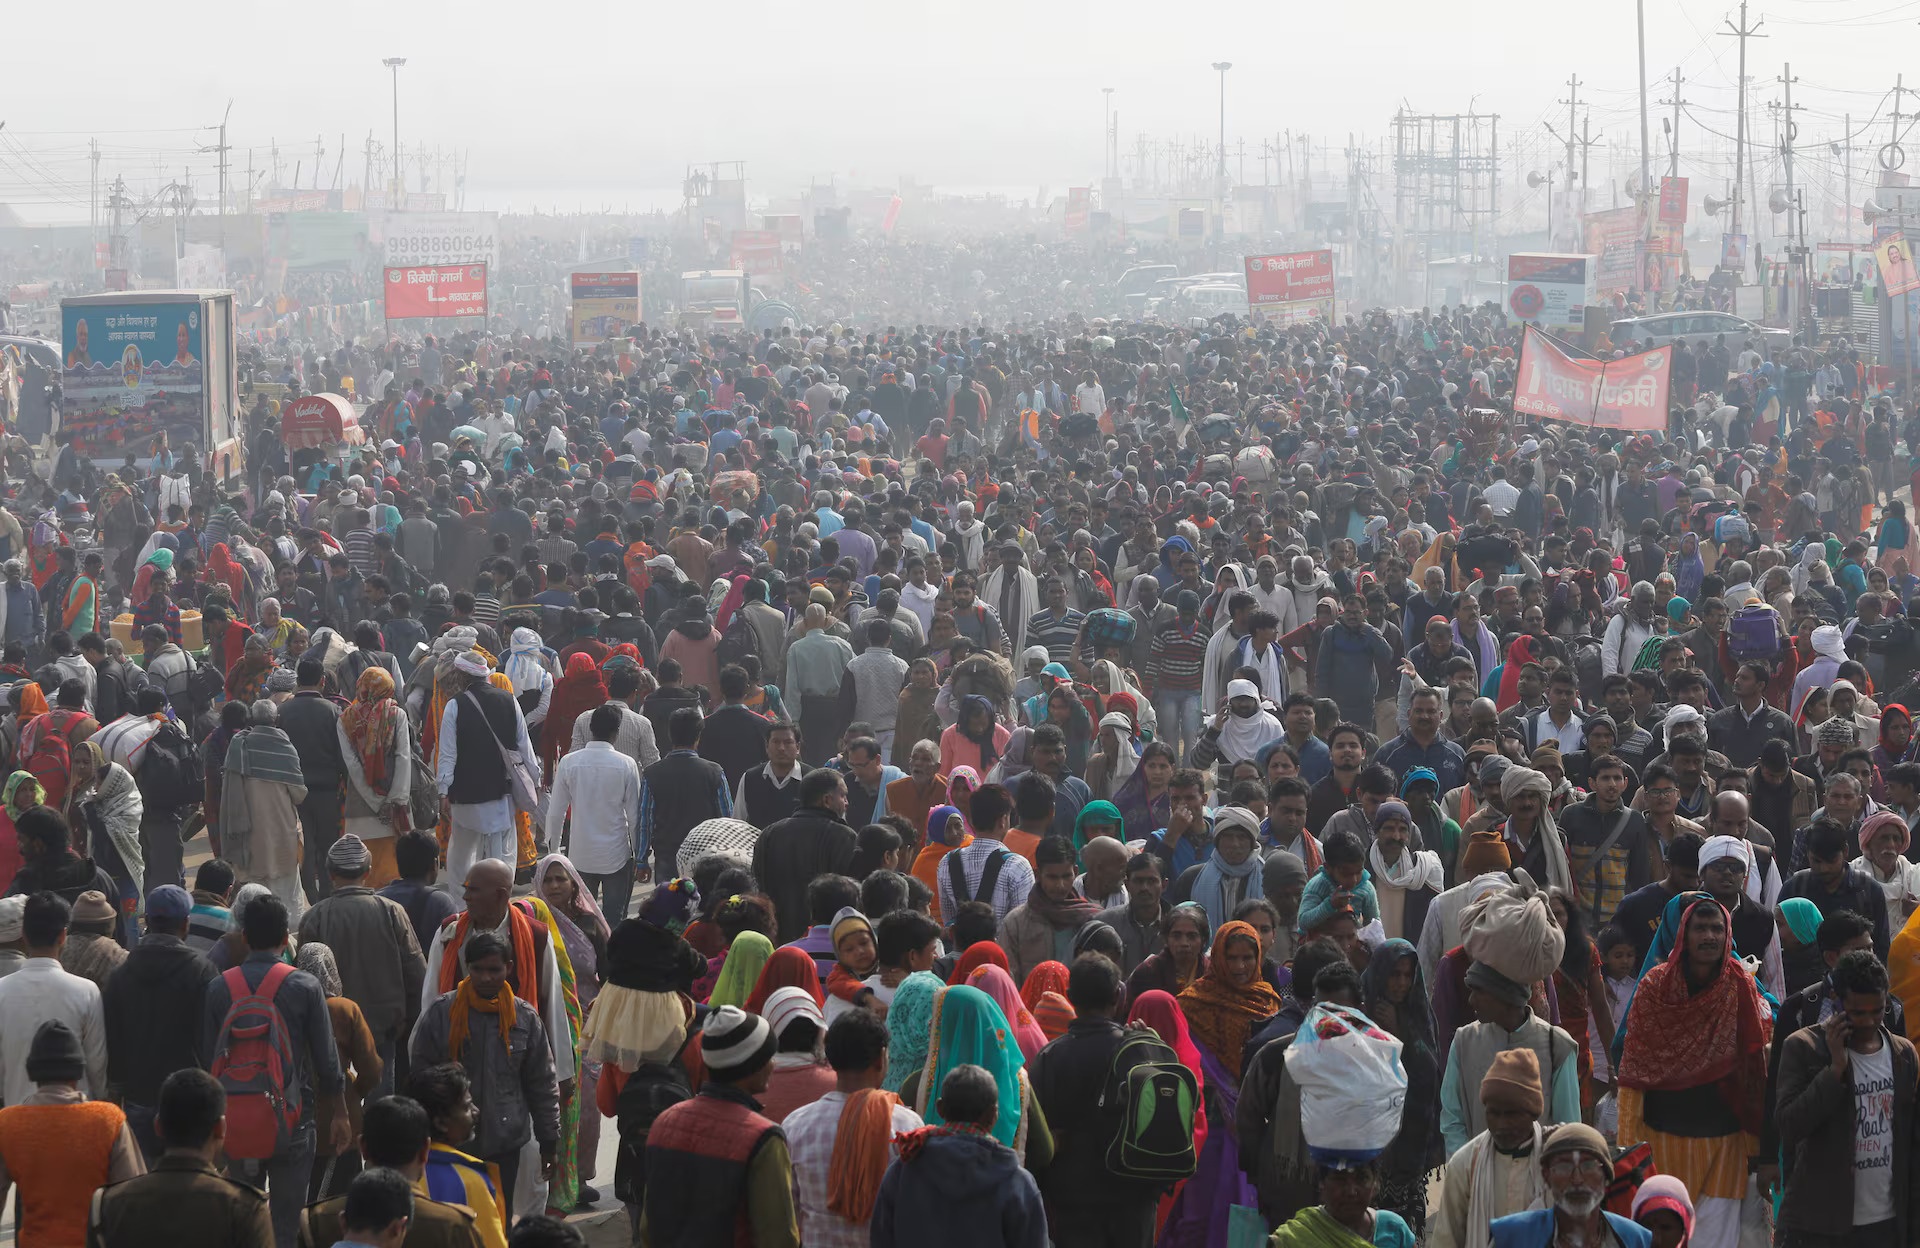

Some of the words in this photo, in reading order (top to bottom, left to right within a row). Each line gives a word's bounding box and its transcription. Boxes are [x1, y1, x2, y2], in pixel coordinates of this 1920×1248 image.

[389, 235, 494, 253] 9988860644
[1267, 257, 1295, 271] त्रिवेणी
[1296, 255, 1314, 269] मार्ग
[407, 270, 438, 284] त्रिवेणी
[440, 268, 463, 282] मार्ग
[295, 403, 326, 418] Vadilal
[1857, 1105, 1889, 1139] Real
